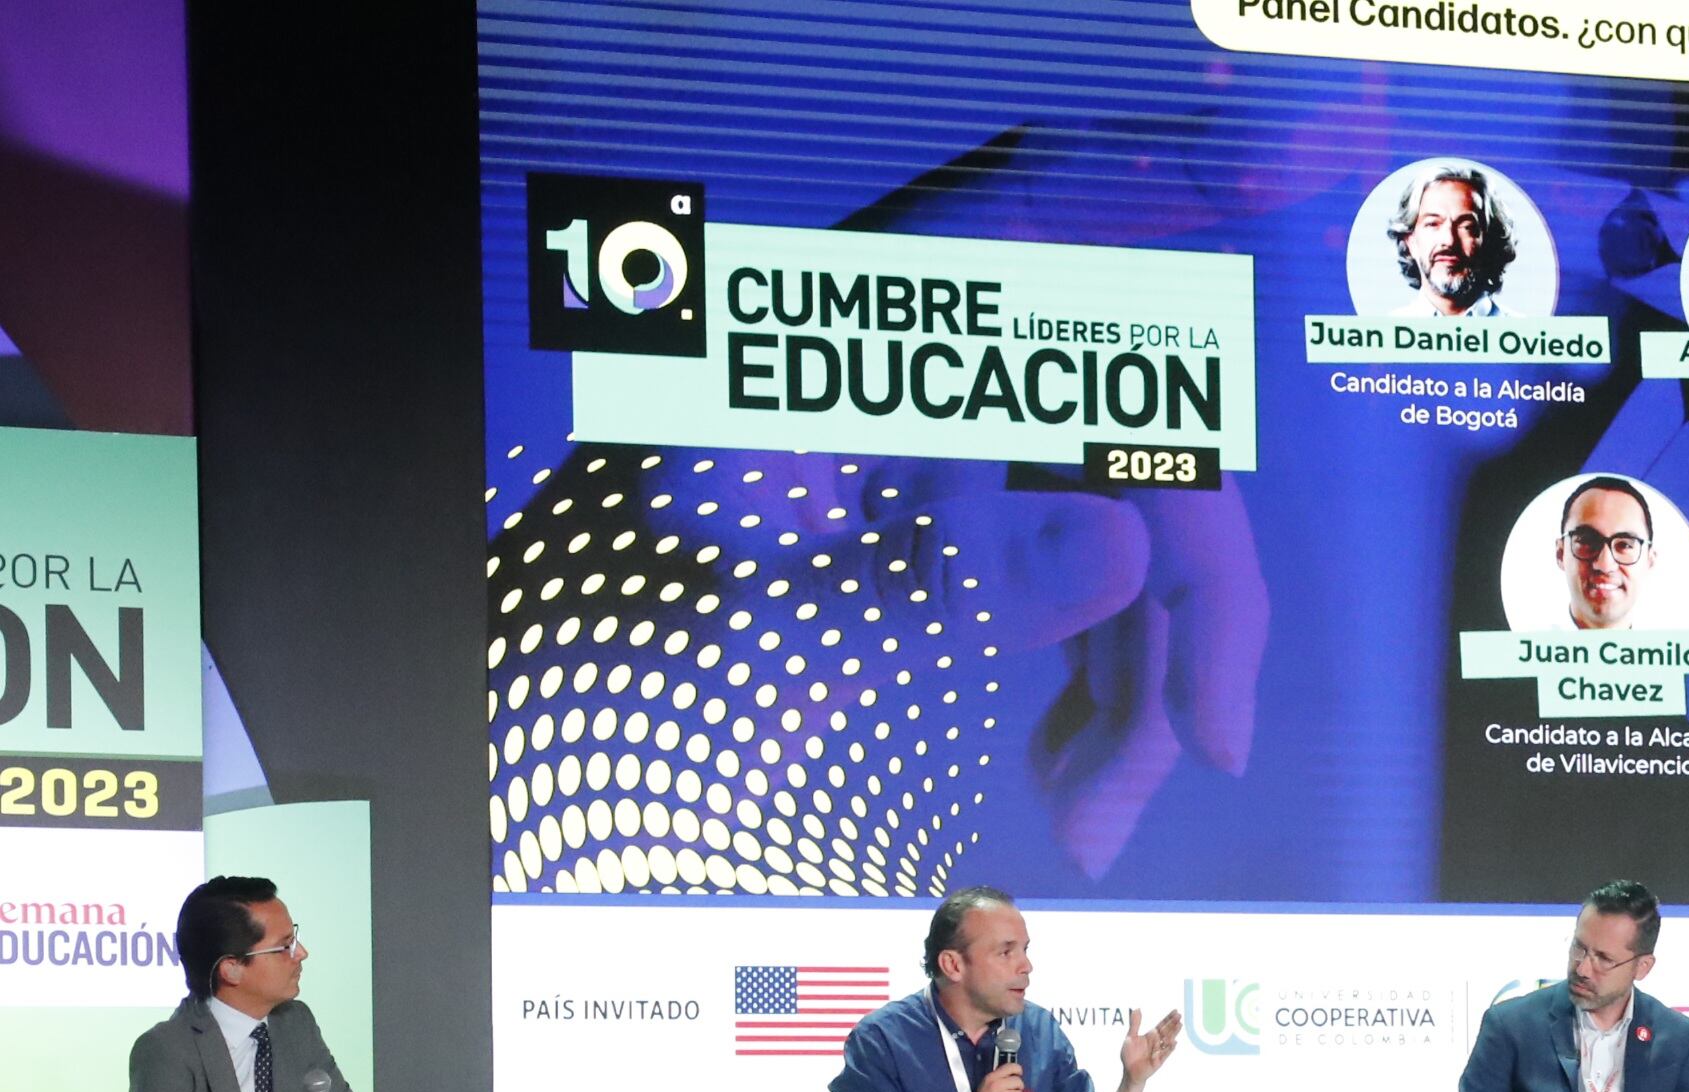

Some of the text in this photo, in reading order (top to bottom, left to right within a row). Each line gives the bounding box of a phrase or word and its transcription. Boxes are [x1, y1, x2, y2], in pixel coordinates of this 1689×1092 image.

[1350, 0, 1569, 39] Candidatos.
[1577, 17, 1658, 47] ¿con
[727, 267, 1221, 351] CUMBRE LÍDERES POR LA
[1310, 321, 1603, 358] Juan Daniel Oviedo
[727, 332, 1222, 432] EDUCACIÓN
[1330, 372, 1585, 402] Candidato a la Alcaldía
[1400, 404, 1518, 431] de Bogotá
[1106, 450, 1197, 482] 2023
[0, 553, 143, 593] OR LA
[1518, 639, 1589, 664] Juan
[1557, 677, 1664, 702] Chavez
[1485, 724, 1601, 746] Candidato
[1606, 731, 1618, 746] a
[1625, 726, 1643, 747] la
[1526, 752, 1555, 773] de
[0, 766, 159, 819] 2023
[522, 995, 701, 1021] PAÍS INVITADO
[1051, 1008, 1132, 1026] INVITA
[1275, 1007, 1435, 1027] COOPERATIVA
[1278, 1033, 1302, 1046] DE
